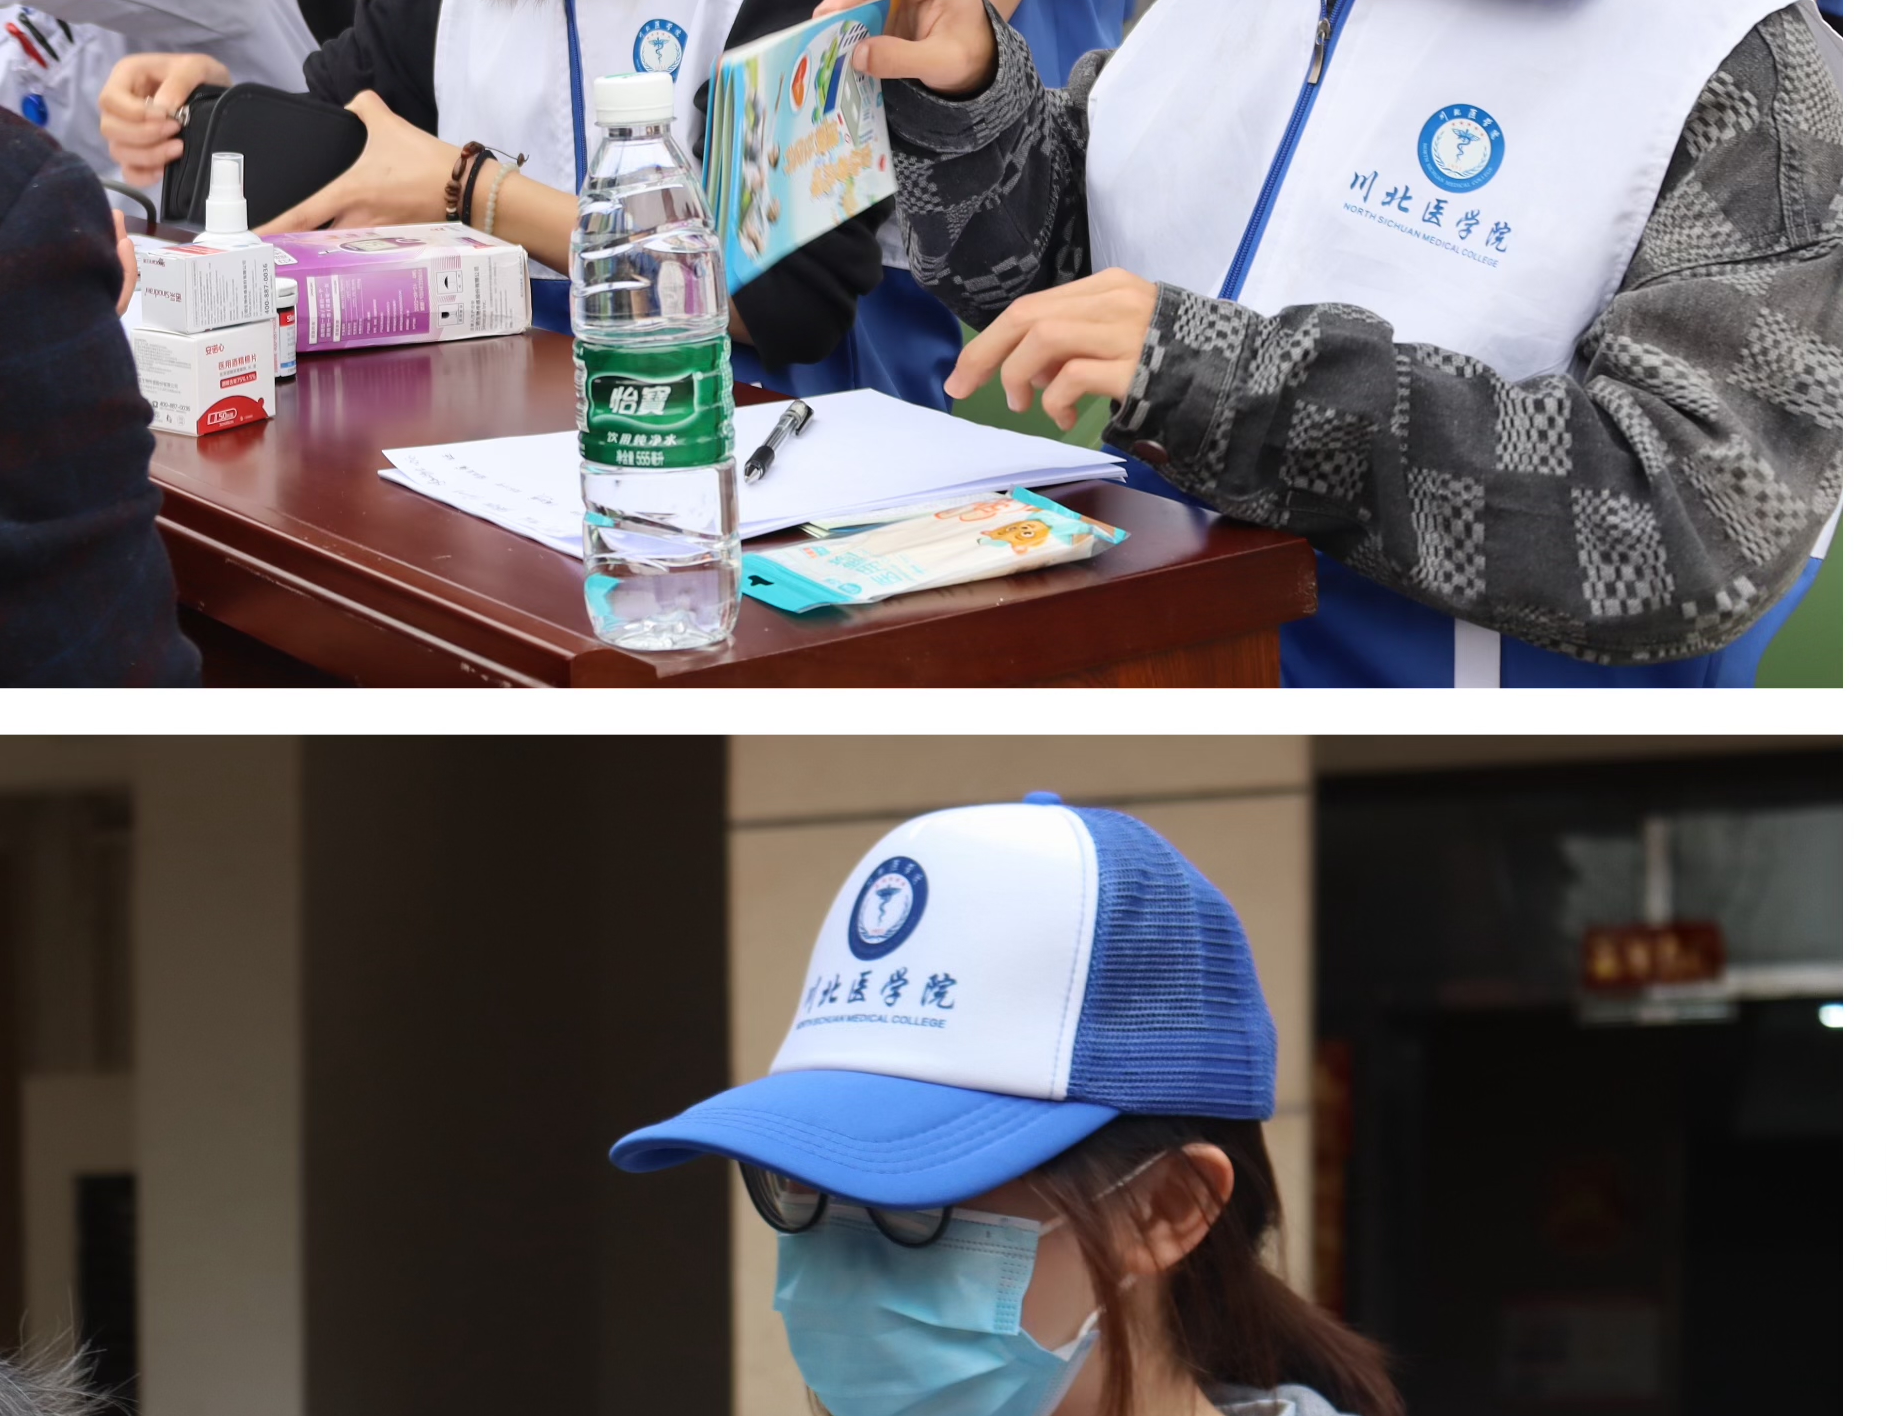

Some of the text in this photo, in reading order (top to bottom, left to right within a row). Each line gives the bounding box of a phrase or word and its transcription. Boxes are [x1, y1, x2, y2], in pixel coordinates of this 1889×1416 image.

[1350, 170, 1513, 254] 川北医学院
[1343, 202, 1500, 269] NORTH SICHUAN MEDICAL COLLEGE
[608, 386, 672, 415] 怡寶
[607, 431, 678, 446] 饮用纯净水
[804, 966, 957, 1013] 川北医学院
[847, 1013, 888, 1024] MEDICAL
[890, 1014, 947, 1029] COLLEGE
